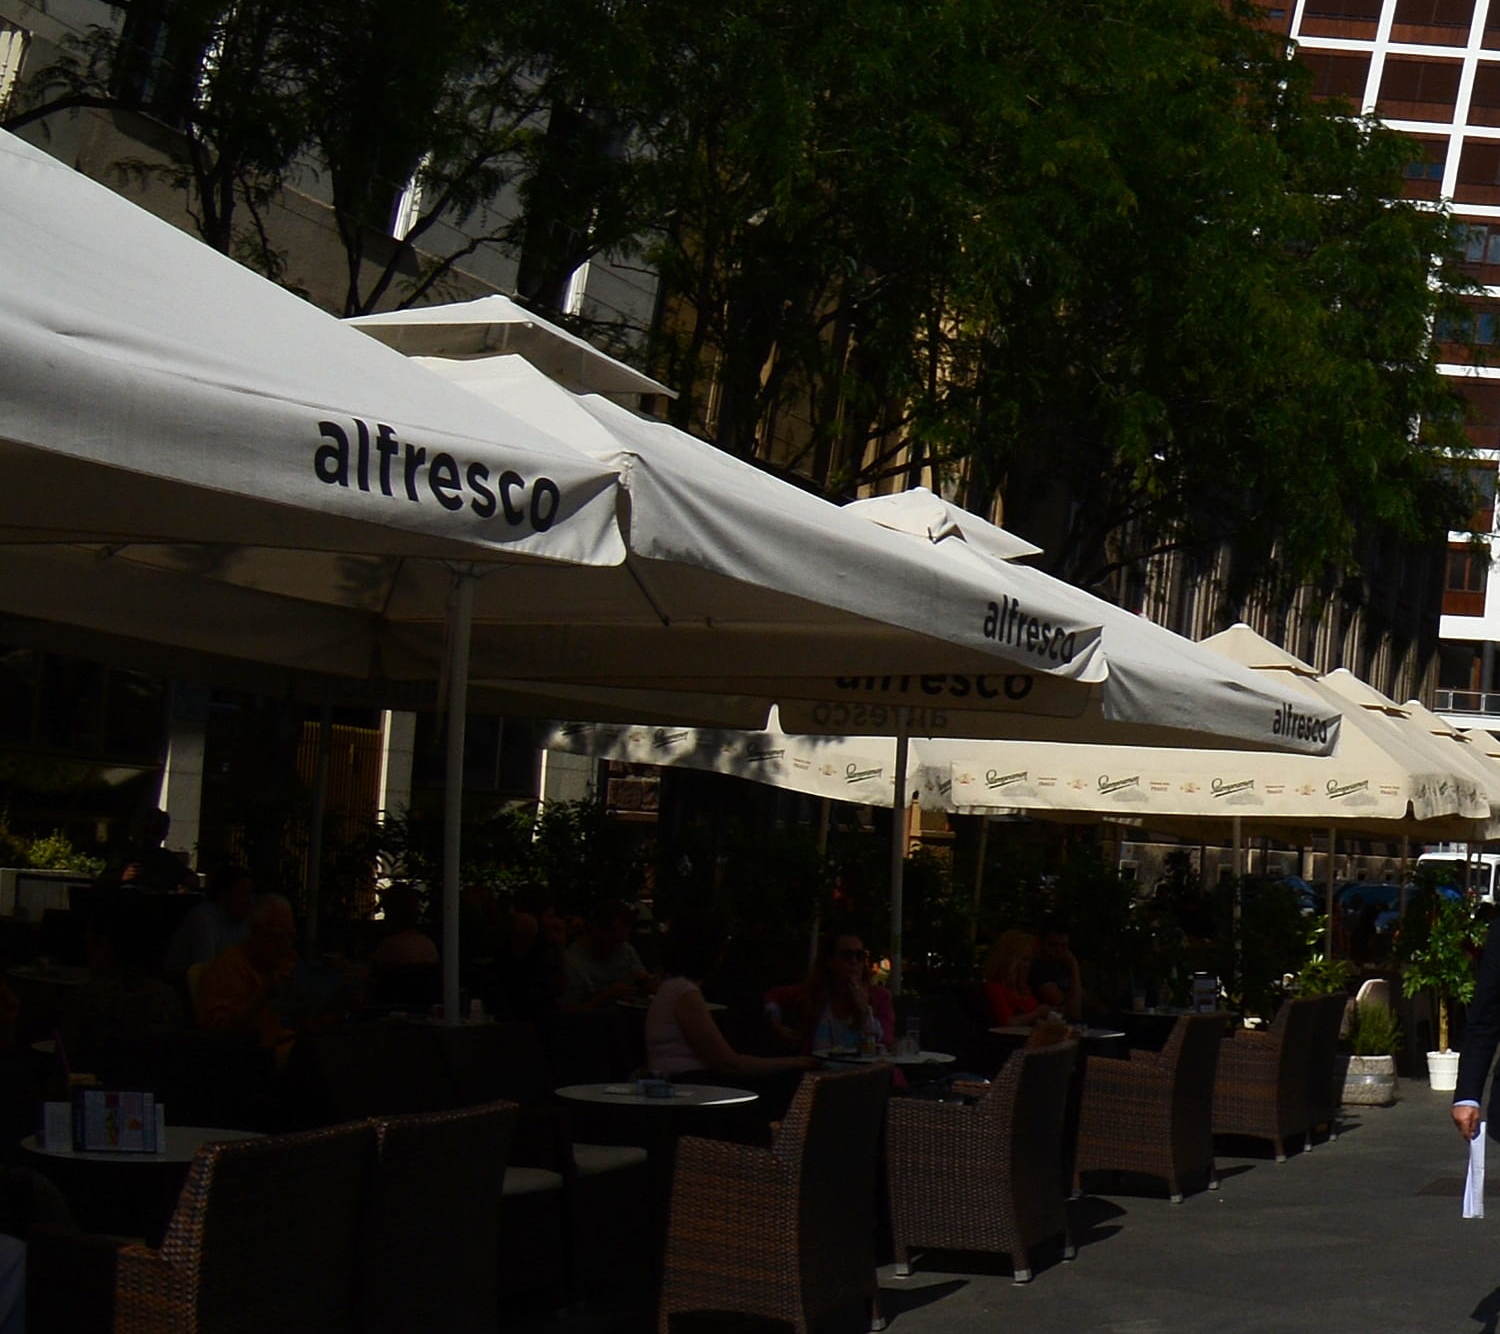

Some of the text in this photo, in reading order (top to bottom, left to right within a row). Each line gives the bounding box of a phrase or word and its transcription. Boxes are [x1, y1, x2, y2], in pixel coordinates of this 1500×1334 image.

[314, 417, 560, 533] alfresco
[984, 594, 1076, 664] alfresco
[1273, 701, 1327, 744] alfresco
